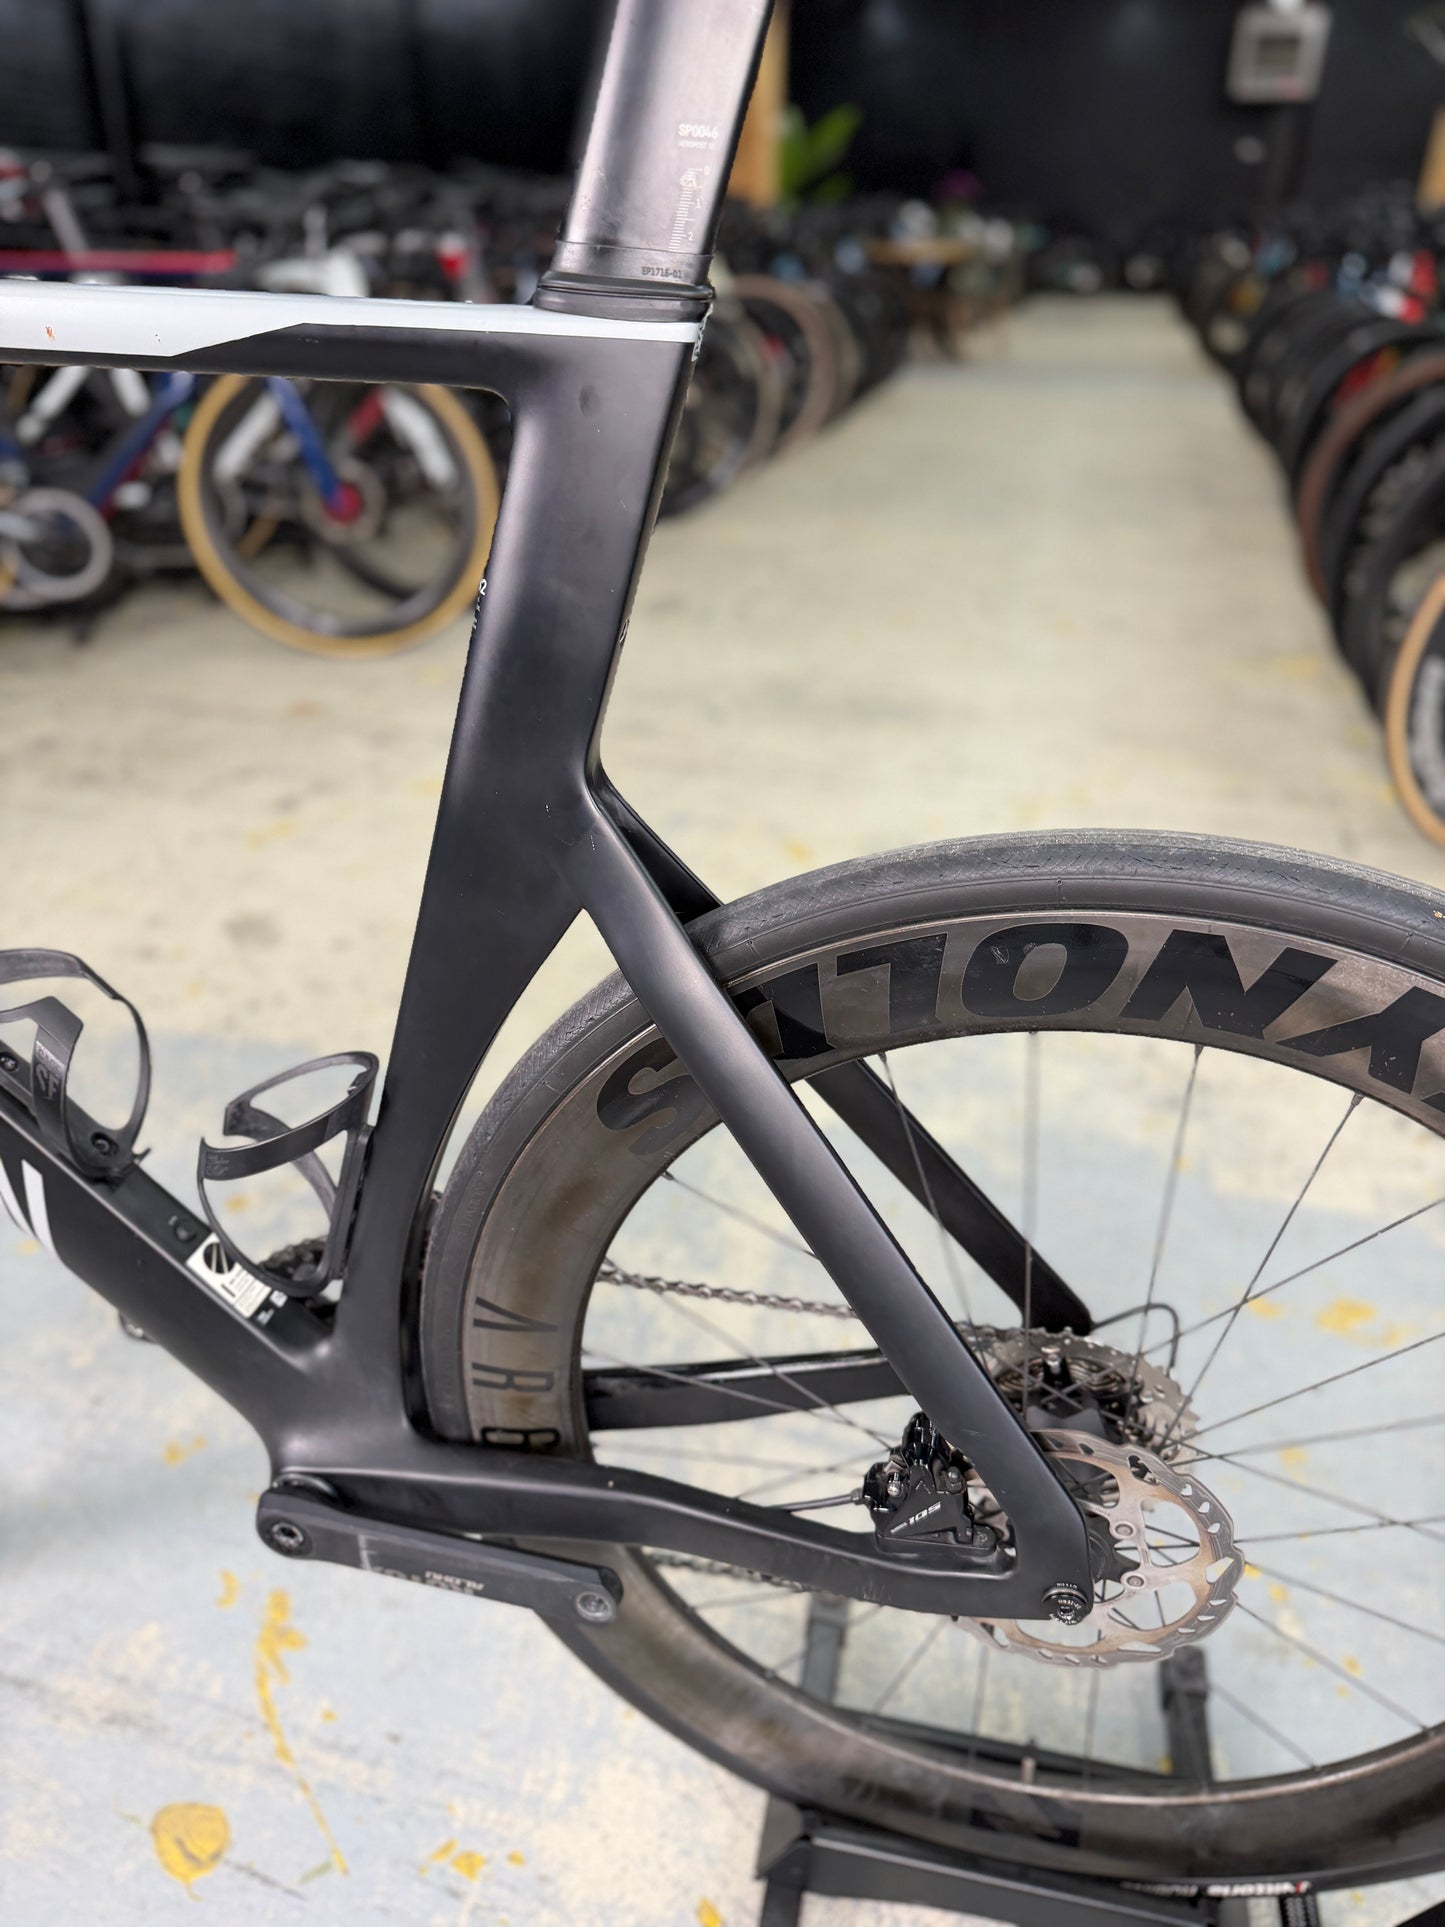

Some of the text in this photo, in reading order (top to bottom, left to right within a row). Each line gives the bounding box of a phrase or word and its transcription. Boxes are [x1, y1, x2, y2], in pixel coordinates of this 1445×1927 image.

[678, 123, 719, 139] SP0046
[688, 231, 694, 241] 2
[908, 1501, 941, 1525] 105
